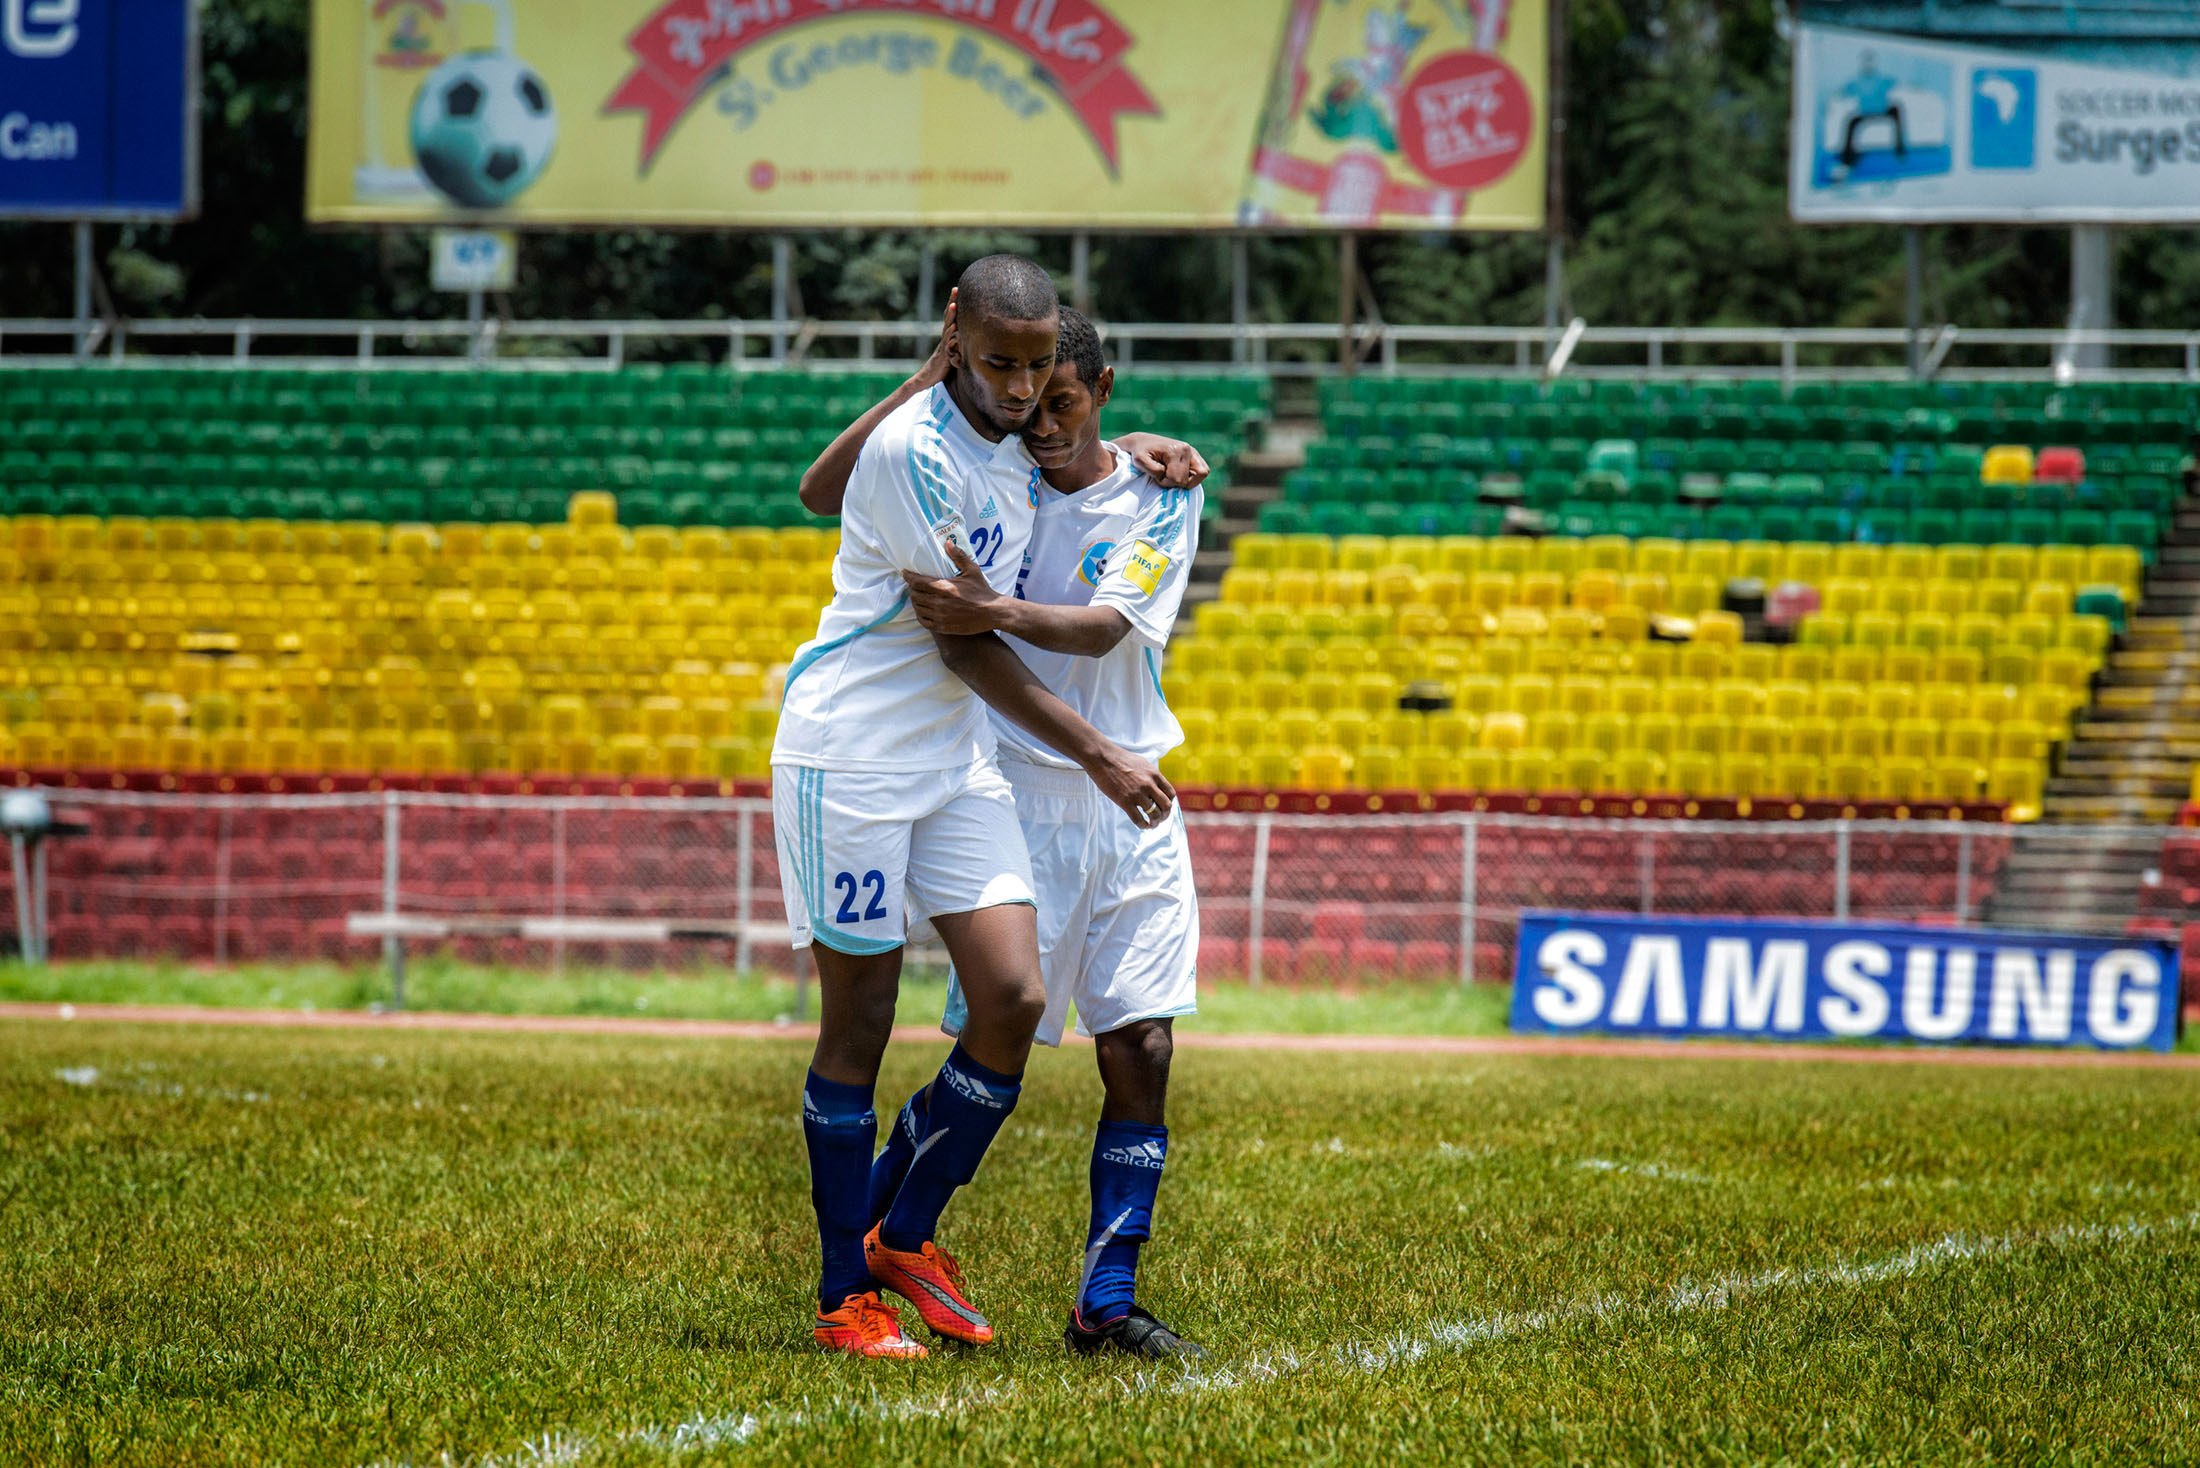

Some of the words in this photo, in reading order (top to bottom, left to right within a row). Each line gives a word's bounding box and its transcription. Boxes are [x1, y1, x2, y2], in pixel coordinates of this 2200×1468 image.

[769, 31, 936, 90] George
[947, 35, 1045, 118] Beer
[0, 111, 78, 160] Can
[970, 523, 1004, 566] 22
[1132, 553, 1152, 571] FIFA
[834, 869, 887, 924] 22
[1532, 929, 2161, 1046] SAMSUNG
